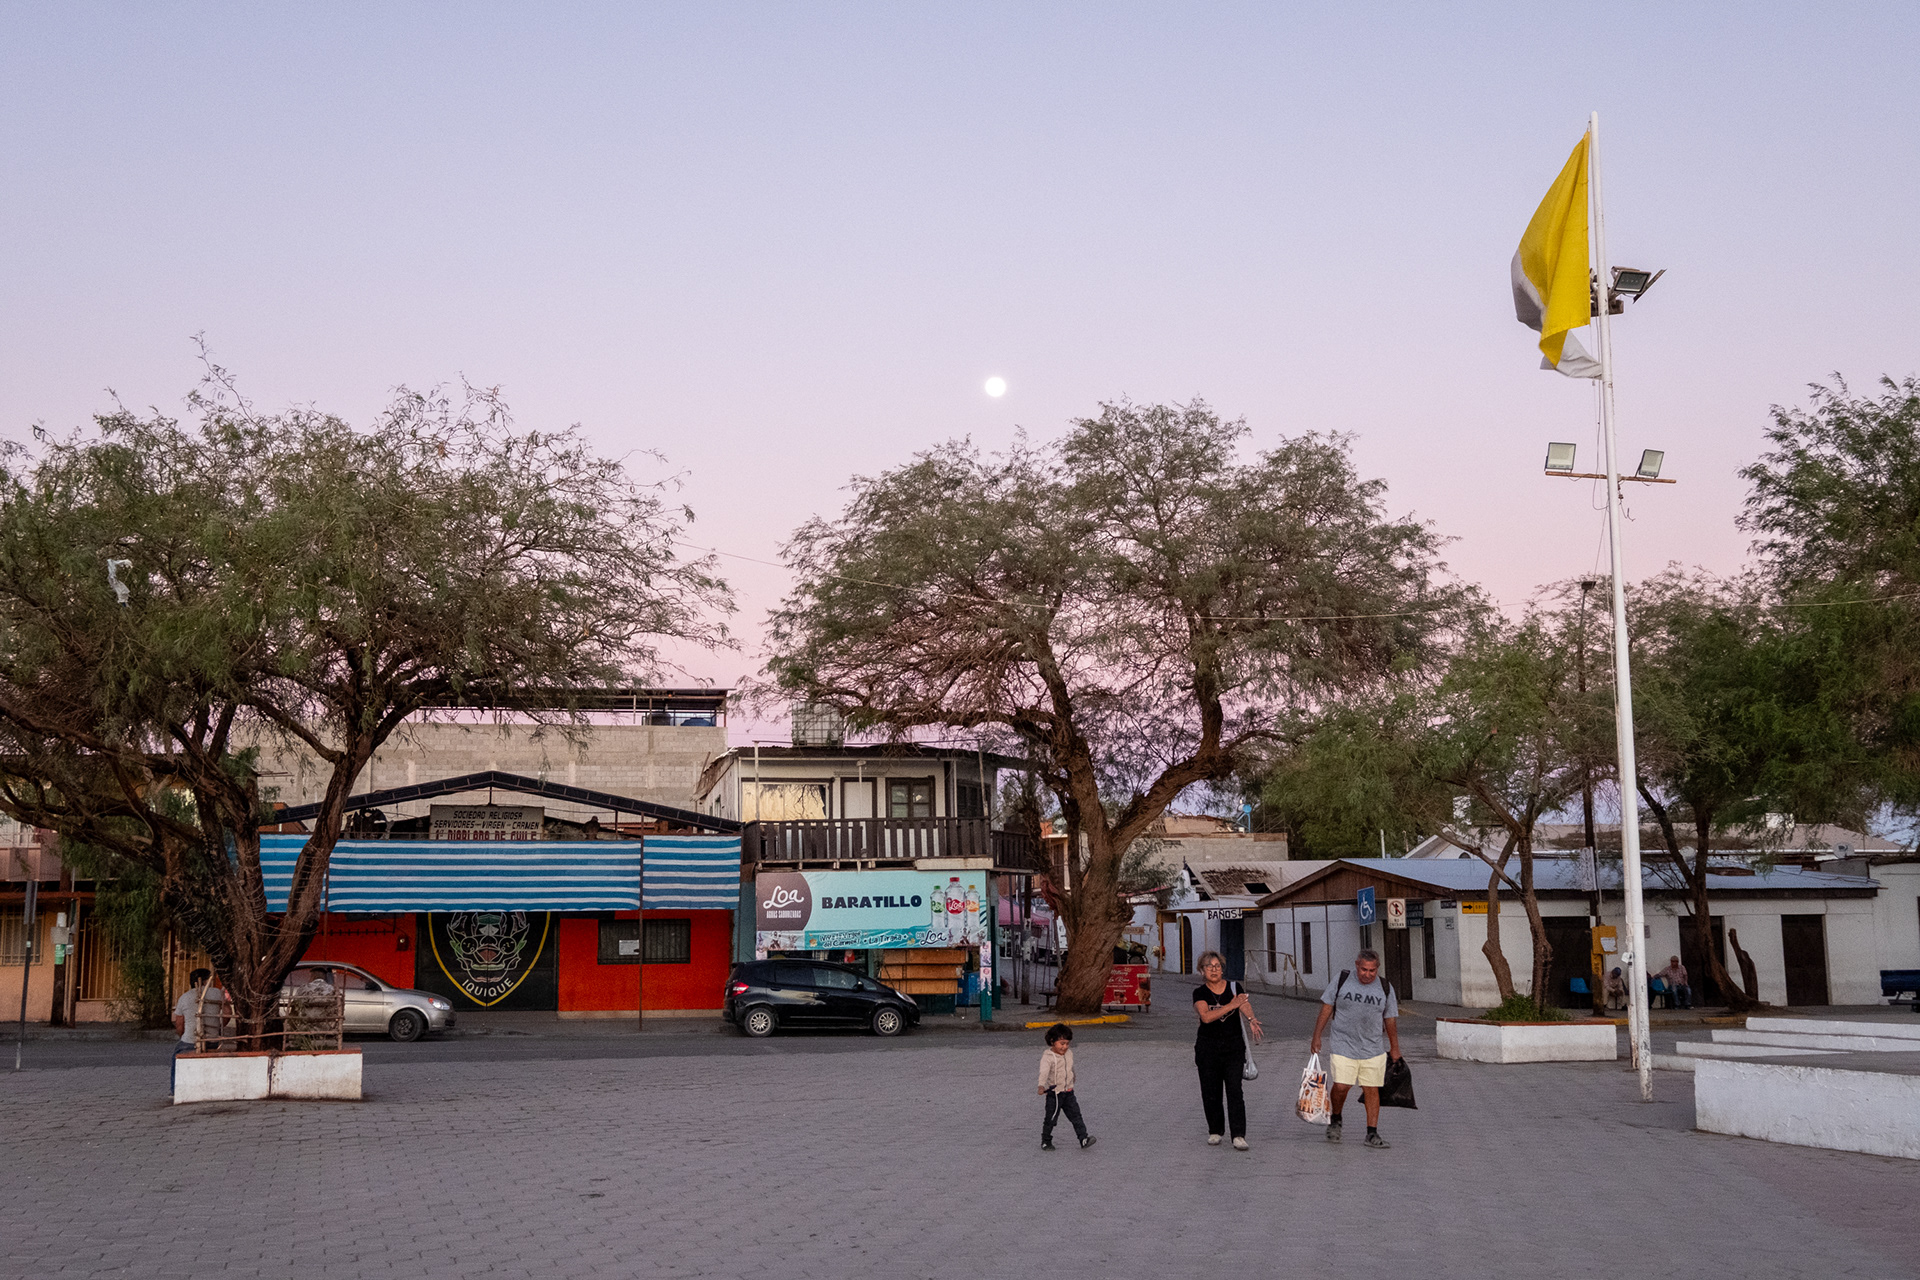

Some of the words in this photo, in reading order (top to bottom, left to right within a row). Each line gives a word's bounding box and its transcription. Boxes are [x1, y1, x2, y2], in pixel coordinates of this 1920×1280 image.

[453, 811, 485, 820] SOCIEDAD
[489, 812, 523, 820] RELIGIOSA
[434, 820, 475, 828] SERVIDORES
[482, 821, 505, 830] VIRGEN
[512, 822, 540, 830] CARMEN
[763, 886, 804, 910] Loa
[822, 894, 922, 909] BARATILLO
[920, 930, 946, 946] Loa
[462, 978, 514, 997] IQUIQUE
[1344, 992, 1382, 1006] ARMY
